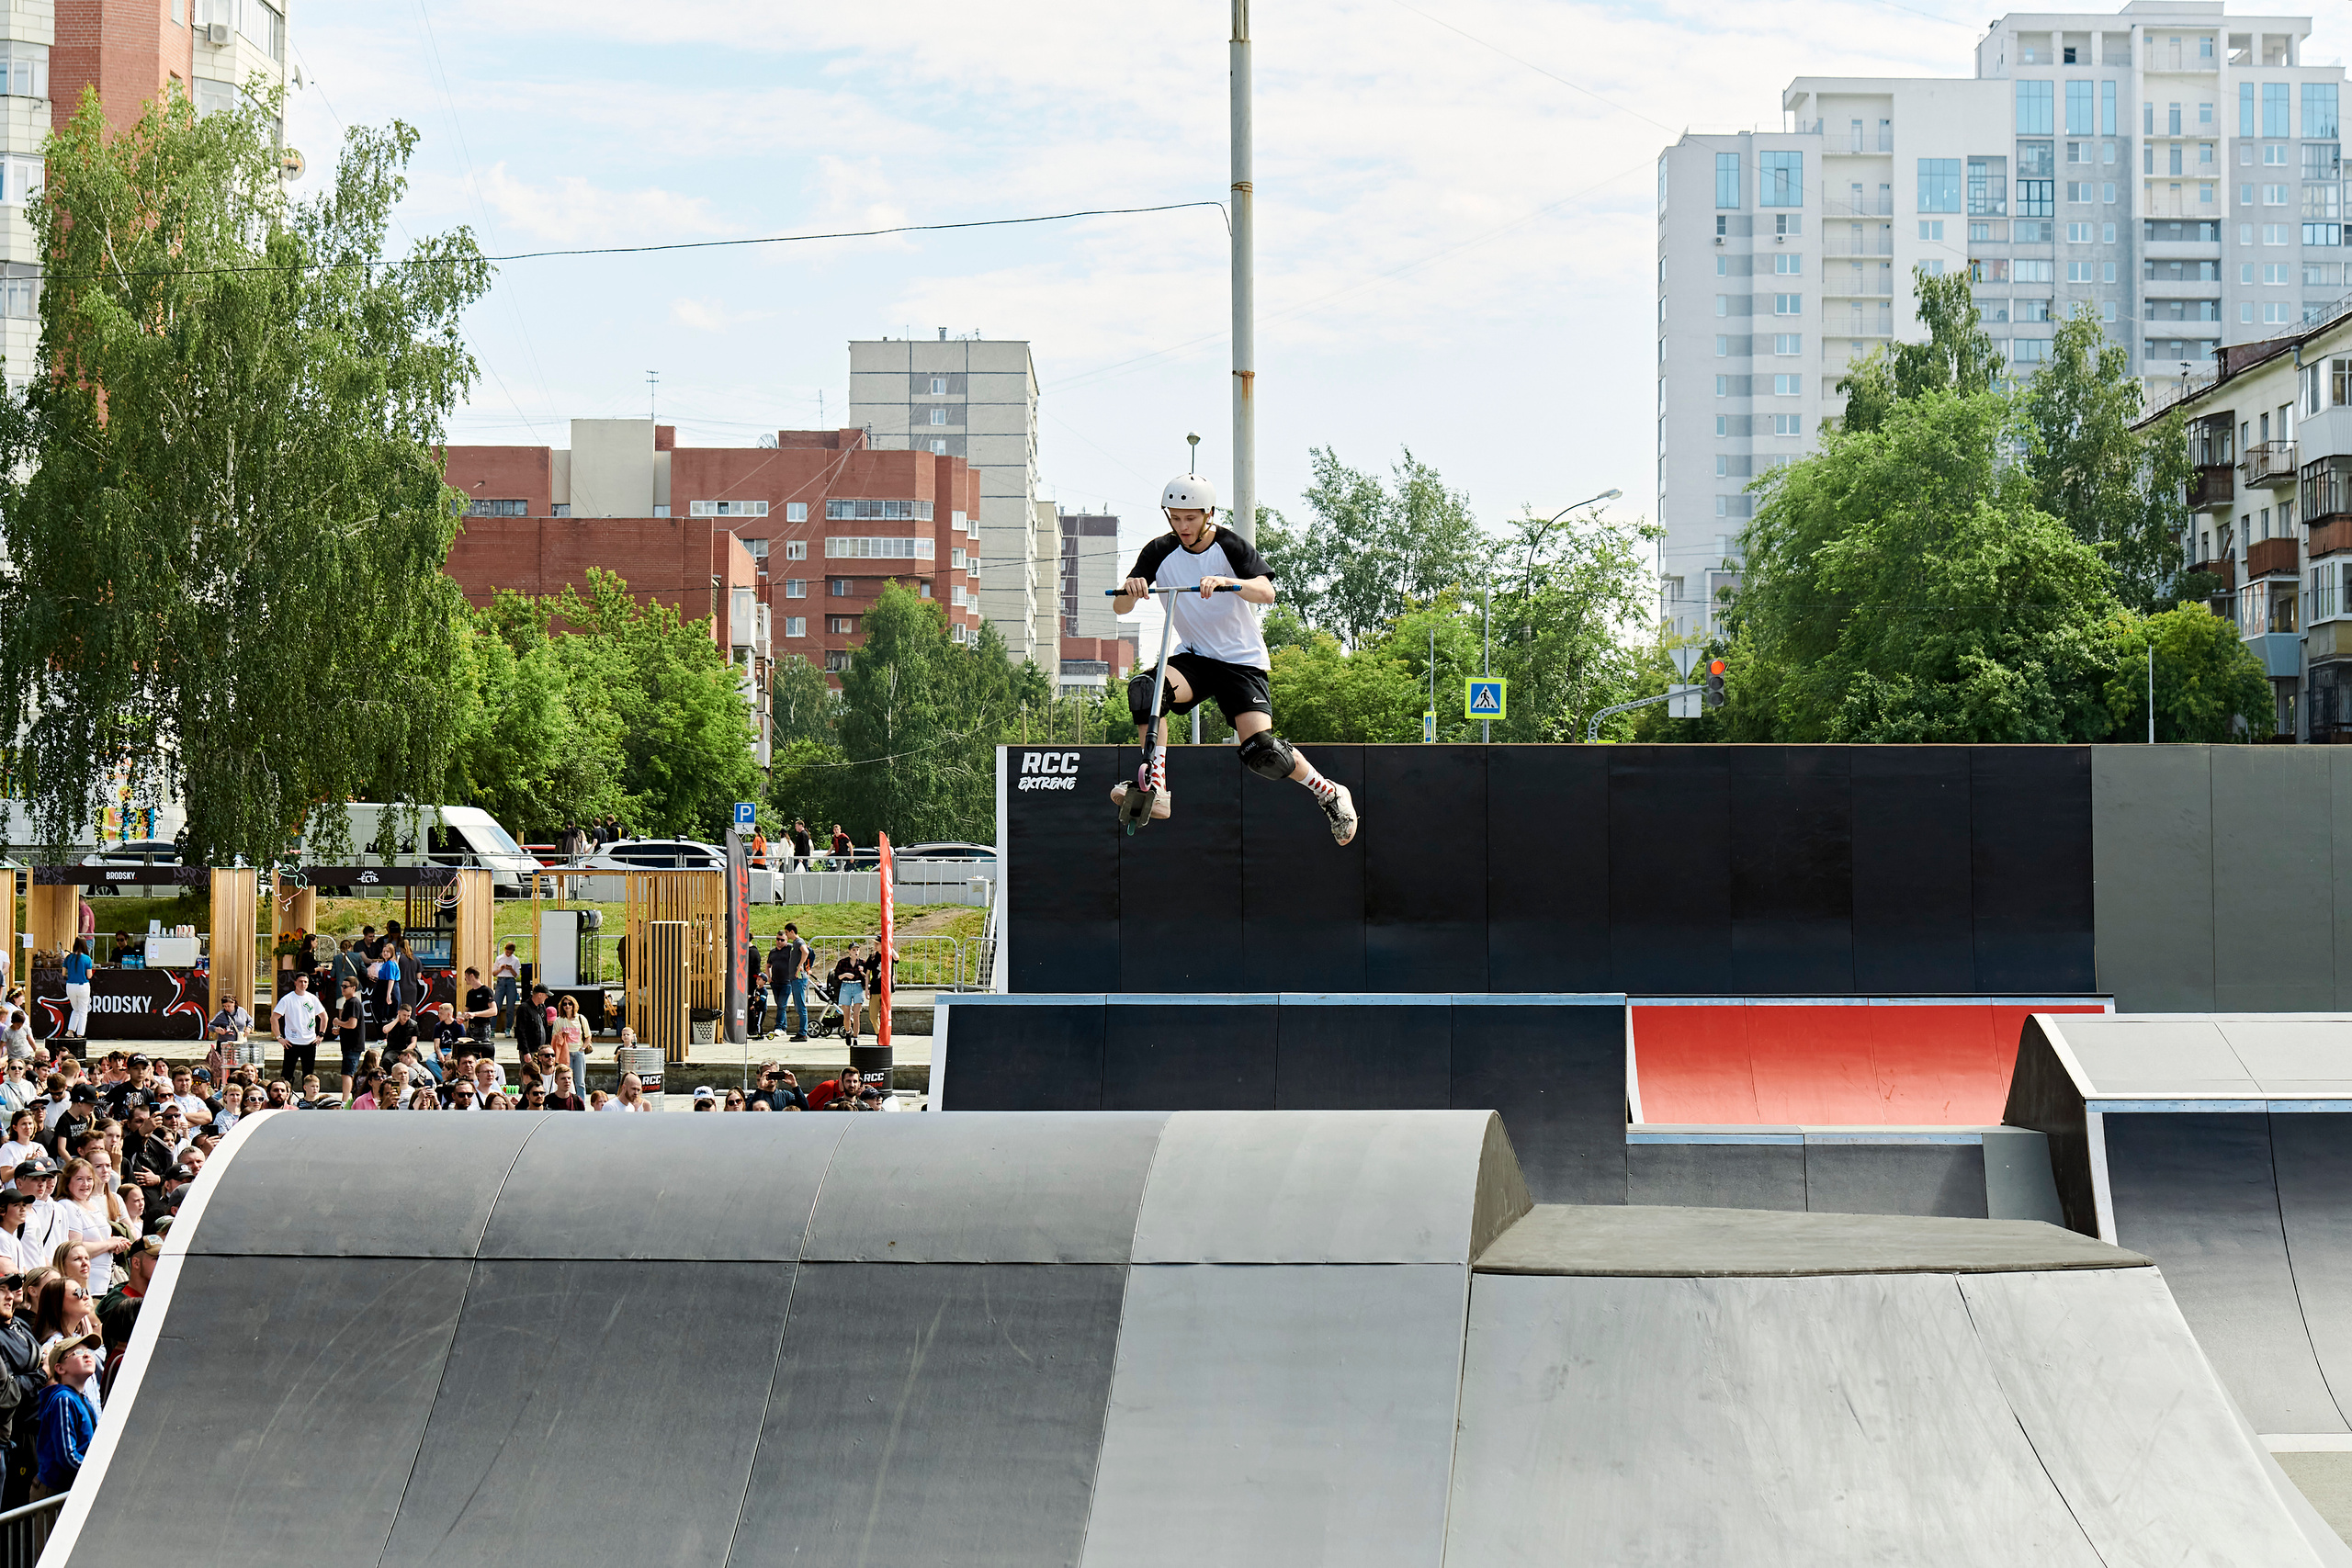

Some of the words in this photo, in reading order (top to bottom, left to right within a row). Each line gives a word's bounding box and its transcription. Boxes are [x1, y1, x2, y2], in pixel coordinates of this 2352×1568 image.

[1021, 751, 1080, 773] RCC
[1018, 776, 1077, 793] EXTREME
[740, 805, 752, 822] P
[736, 863, 750, 995] EXTREME
[642, 1075, 662, 1085] RCC
[864, 1072, 885, 1082] RCC
